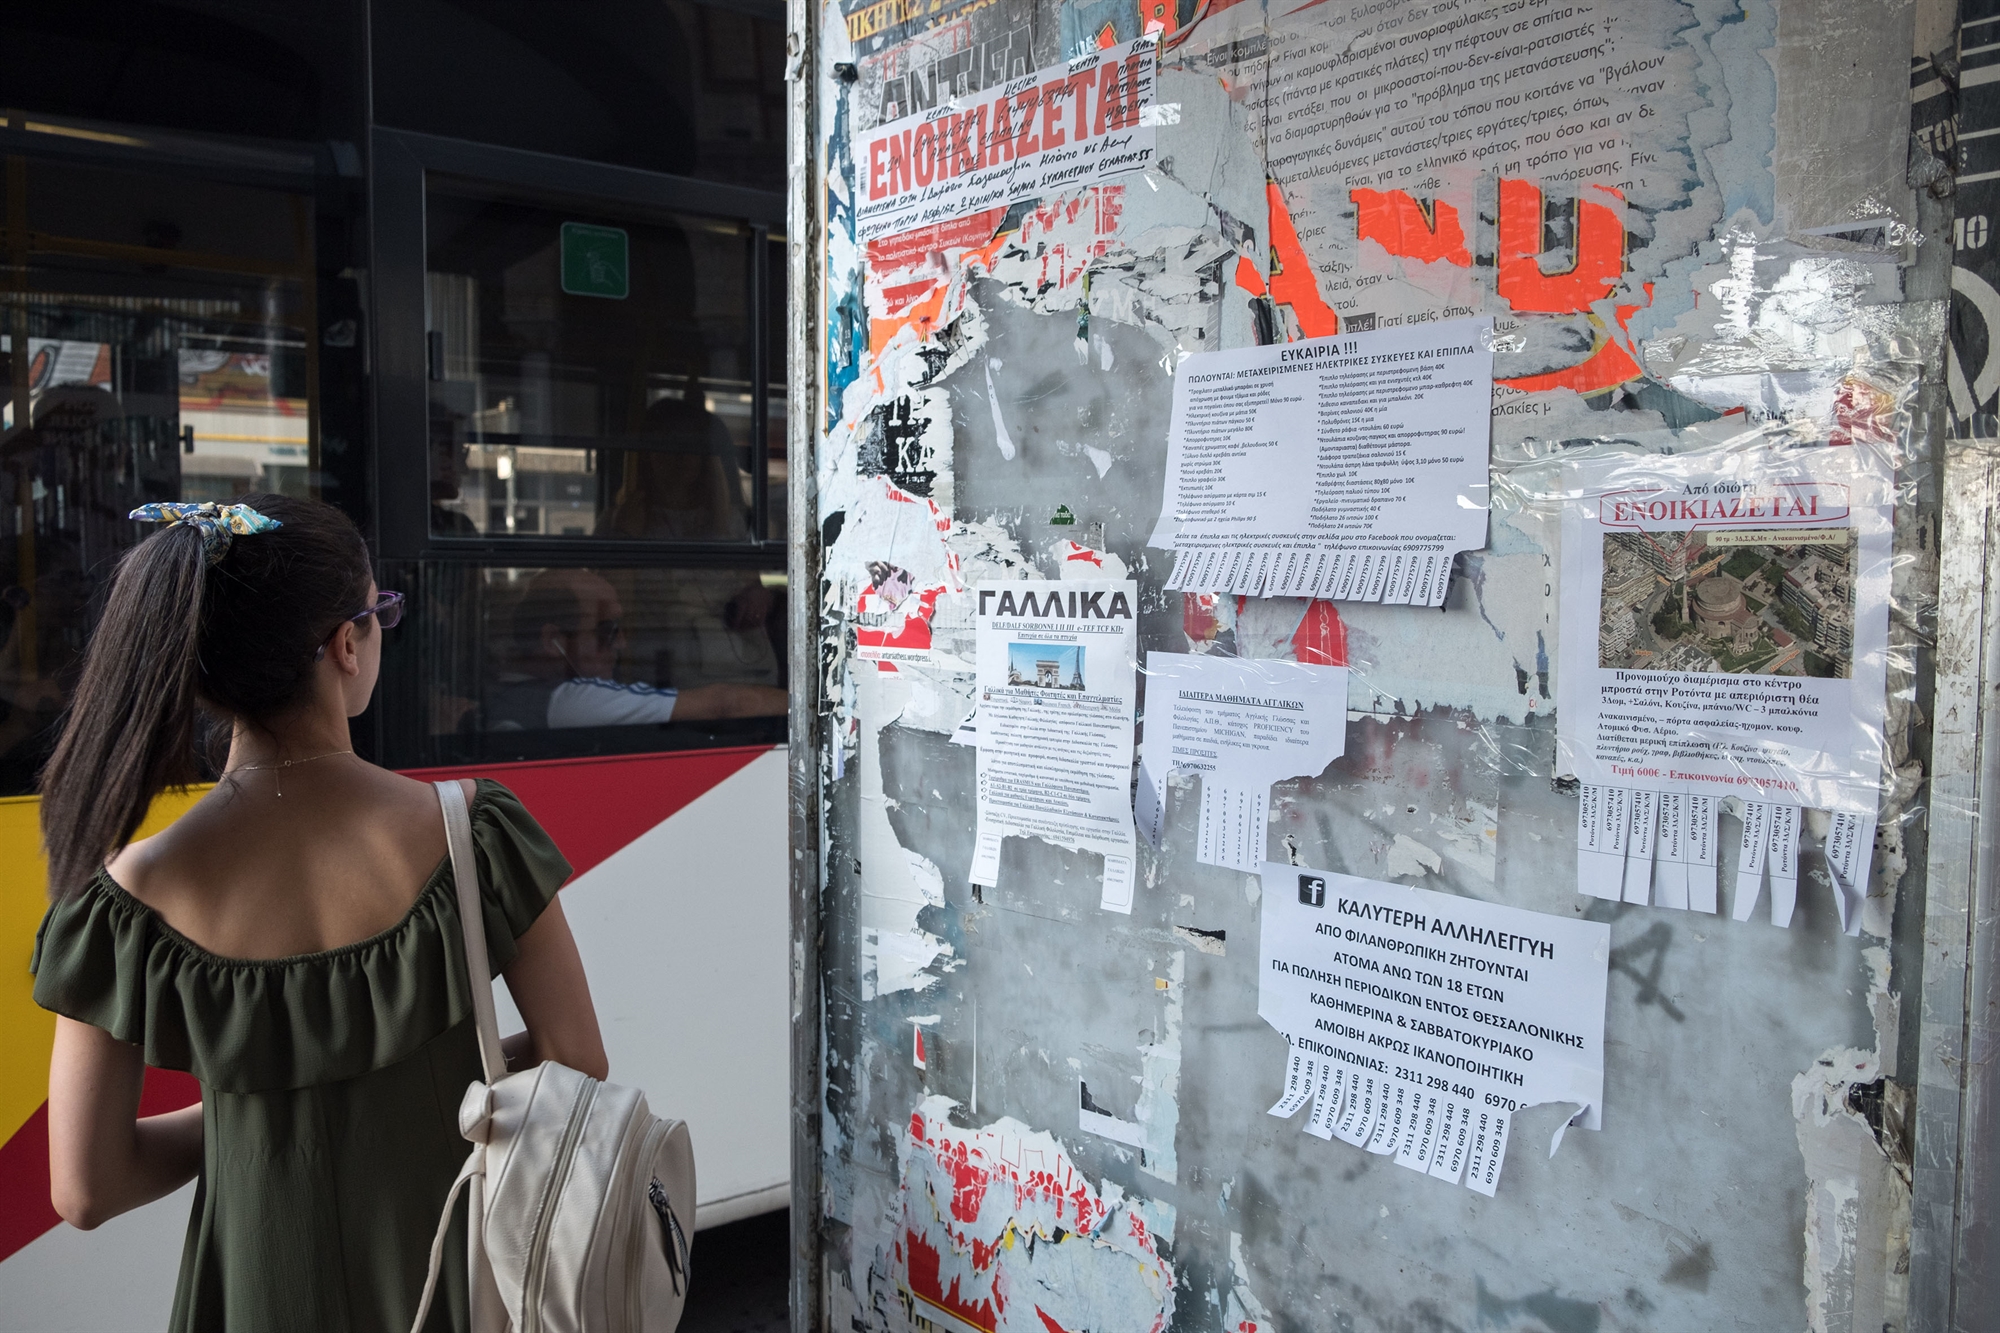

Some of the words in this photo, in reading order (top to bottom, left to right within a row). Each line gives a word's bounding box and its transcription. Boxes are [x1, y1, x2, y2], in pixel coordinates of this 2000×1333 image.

[1282, 84, 1317, 106] (πάντα
[1319, 80, 1332, 96] με
[1335, 63, 1383, 89] κρατικές
[1384, 47, 1429, 72] πλάτες)
[1432, 42, 1453, 59] την
[1454, 26, 1510, 51] πέφτουν
[1512, 20, 1529, 34] σε
[1532, 7, 1573, 28] σπίτια
[1296, 39, 1396, 79] καμουφλαρισμένοι
[1399, 7, 1499, 47] συνοριοφύλακες
[1271, 132, 1282, 145] να
[1284, 108, 1372, 141] διαμαρτυρηθούν
[1374, 103, 1391, 120] για
[1393, 99, 1409, 111] το
[1411, 79, 1476, 107] "πρόβλημα
[1479, 75, 1500, 89] της
[1504, 39, 1615, 83] μετανάστευσης";
[1287, 100, 1328, 121] εντάξει
[1329, 94, 1351, 109] που
[1356, 90, 1368, 101] οι
[1334, 125, 1387, 152] δυνάμεις"
[1390, 116, 1426, 137] αυτού
[1428, 112, 1449, 127] του
[1452, 101, 1492, 120] τόπου
[1495, 94, 1521, 110] που
[1524, 80, 1575, 102] κοιτάνε
[1578, 74, 1595, 87] να
[1600, 55, 1665, 85] "βγάλουν
[869, 54, 1140, 201] ΕΝΟΙΚΙΑΖΕΤΑΙ
[1373, 128, 1473, 167] μετανάστες/τριες
[1476, 105, 1568, 139] εργάτες/τριες,
[1572, 96, 1610, 112] όπως
[1472, 139, 1521, 161] κράτος,
[1525, 131, 1551, 146] που
[1555, 123, 1585, 139] όσο
[1590, 117, 1611, 131] και
[1615, 110, 1633, 124] αν
[1504, 160, 1521, 176] μη
[1525, 149, 1568, 170] τρόπο
[1573, 143, 1593, 161] για
[1598, 138, 1615, 151] να
[1377, 315, 1403, 329] Γιατί
[1406, 310, 1439, 326] εμείς,
[1442, 305, 1475, 318] όπως
[1188, 371, 1236, 384] ΠΩΛΟΥΝΤΑΙ:
[1236, 362, 1314, 379] ΜΕΤΑΧΕΙΡΙΣΜΕΝΕΣ
[1315, 356, 1369, 370] ΗΛΕΚΤΡΙΚΕΣ
[1370, 351, 1415, 365] ΣΥΣΚΕΥΕΣ
[1417, 349, 1434, 360] ΚΑΙ
[1436, 345, 1475, 358] ΕΠΙΠΛΑ
[1281, 344, 1341, 362] ΕΥΚΑΙΡΙΑ
[1344, 341, 1358, 355] !!!
[1682, 482, 1710, 496] Από
[1714, 481, 1758, 495] ιδιώτη
[1613, 495, 1819, 522] ΕΝΟΙΚΙΑΖΕΤΑΙ
[1238, 532, 1271, 540] ηλεκτρικές
[1271, 532, 1301, 540] συσκευές
[1317, 532, 1340, 541] σελίδα
[1340, 534, 1355, 542] μου
[1367, 533, 1400, 541] Facebook
[1414, 533, 1457, 543] ονομαζεται:
[978, 590, 1133, 620] ΓΑΛΛΙΚΑ
[1601, 685, 1643, 696] μπροστά
[1644, 688, 1669, 698] στην
[1671, 687, 1712, 699] Ροτόντα
[1714, 691, 1727, 701] με
[1729, 691, 1796, 706] απεριόριστη
[1798, 693, 1820, 705] θέα
[1616, 671, 1681, 686] Προνομιούχο
[1682, 673, 1740, 688] διαμέρισμα
[1742, 679, 1762, 687] στο
[1764, 678, 1802, 692] κέντρο
[1178, 689, 1214, 701] ΙΔΙΑΙΤΕΡΑ
[1215, 693, 1262, 706] ΜΑΘΗΜΑΤΑ
[1263, 698, 1305, 710] ΑΓΓΛΙΚΩΝ
[1601, 695, 1627, 707] 3Δωμ,
[1628, 697, 1663, 708] +Σαλόνι,
[1665, 699, 1701, 711] Κουζίνα,
[1702, 702, 1753, 713] μπάνιο/WC
[1768, 706, 1818, 717] μπαλκόνια
[1213, 728, 1247, 739] MICHIGAN,
[1253, 722, 1294, 734] PROFICIENCY
[1597, 711, 1658, 724] Ανακαινισμένο,
[1666, 716, 1691, 727] πόρτα
[1692, 718, 1774, 732] ασφαλείας-ηχομον.
[1776, 725, 1803, 735] κουφ.
[1597, 722, 1630, 733] Ατομικό
[1631, 724, 1651, 734] Φυσ.
[1652, 726, 1679, 737] Αέριο.
[1610, 764, 1635, 778] Τιμή
[1636, 767, 1660, 778] 600€
[1669, 769, 1734, 784] Επικοινωνία
[1337, 897, 1426, 932] ΚΑΛΥΤΕΡΗ
[1430, 918, 1554, 960] ΑΛΛΗΛΕΓΓΥΗ
[1314, 922, 1342, 939] ΑΠΟ
[1344, 928, 1446, 963] ΦΙΛΑΝΘΡΩΠΙΚΗ
[1449, 952, 1529, 983] ΖΗΤΟΥΝΤΑΙ
[1333, 951, 1380, 973] ΑΤΟΜΑ
[1382, 963, 1412, 981] ΑΝΩ
[1414, 970, 1443, 989] ΤΩΝ
[1447, 978, 1463, 993] 18
[1466, 982, 1504, 1003] ΕΤΩΝ
[1272, 959, 1290, 974] ΓΙΑ
[1292, 964, 1341, 987] ΠΩΛΗΣΗ
[1344, 977, 1422, 1008] ΠΕΡΙΟΔΙΚΩΝ
[1425, 998, 1470, 1020] ΕΝΤΟΣ
[1472, 1010, 1584, 1050] ΘΕΣΣΑΛΟΝΙΚΗΣ
[1310, 992, 1394, 1025] ΚΑΘΗΜΕΡΙΝΑ
[1396, 1014, 1407, 1029] &
[1410, 1018, 1534, 1062] ΣΑΒΒΑΤΟΚΥΡΙΑΚΟ
[1314, 1018, 1365, 1042] ΑΜΟΙΒΗ
[1367, 1033, 1411, 1055] ΑΚΡΩΣ
[1413, 1045, 1524, 1087] ΙΚΑΝΟΠΟΙΗΤΙΚΗ
[1298, 1036, 1389, 1074] ΕΠΙΚΟΙΝΩΝΙΑΣ:
[1394, 1066, 1423, 1085] 2311
[1426, 1075, 1449, 1092] 298
[1451, 1083, 1475, 1100] 440
[1484, 1092, 1517, 1112] 6970
[1494, 1118, 1505, 1138] 348
[1490, 1138, 1501, 1158] 609
[1485, 1159, 1497, 1185] 6970
